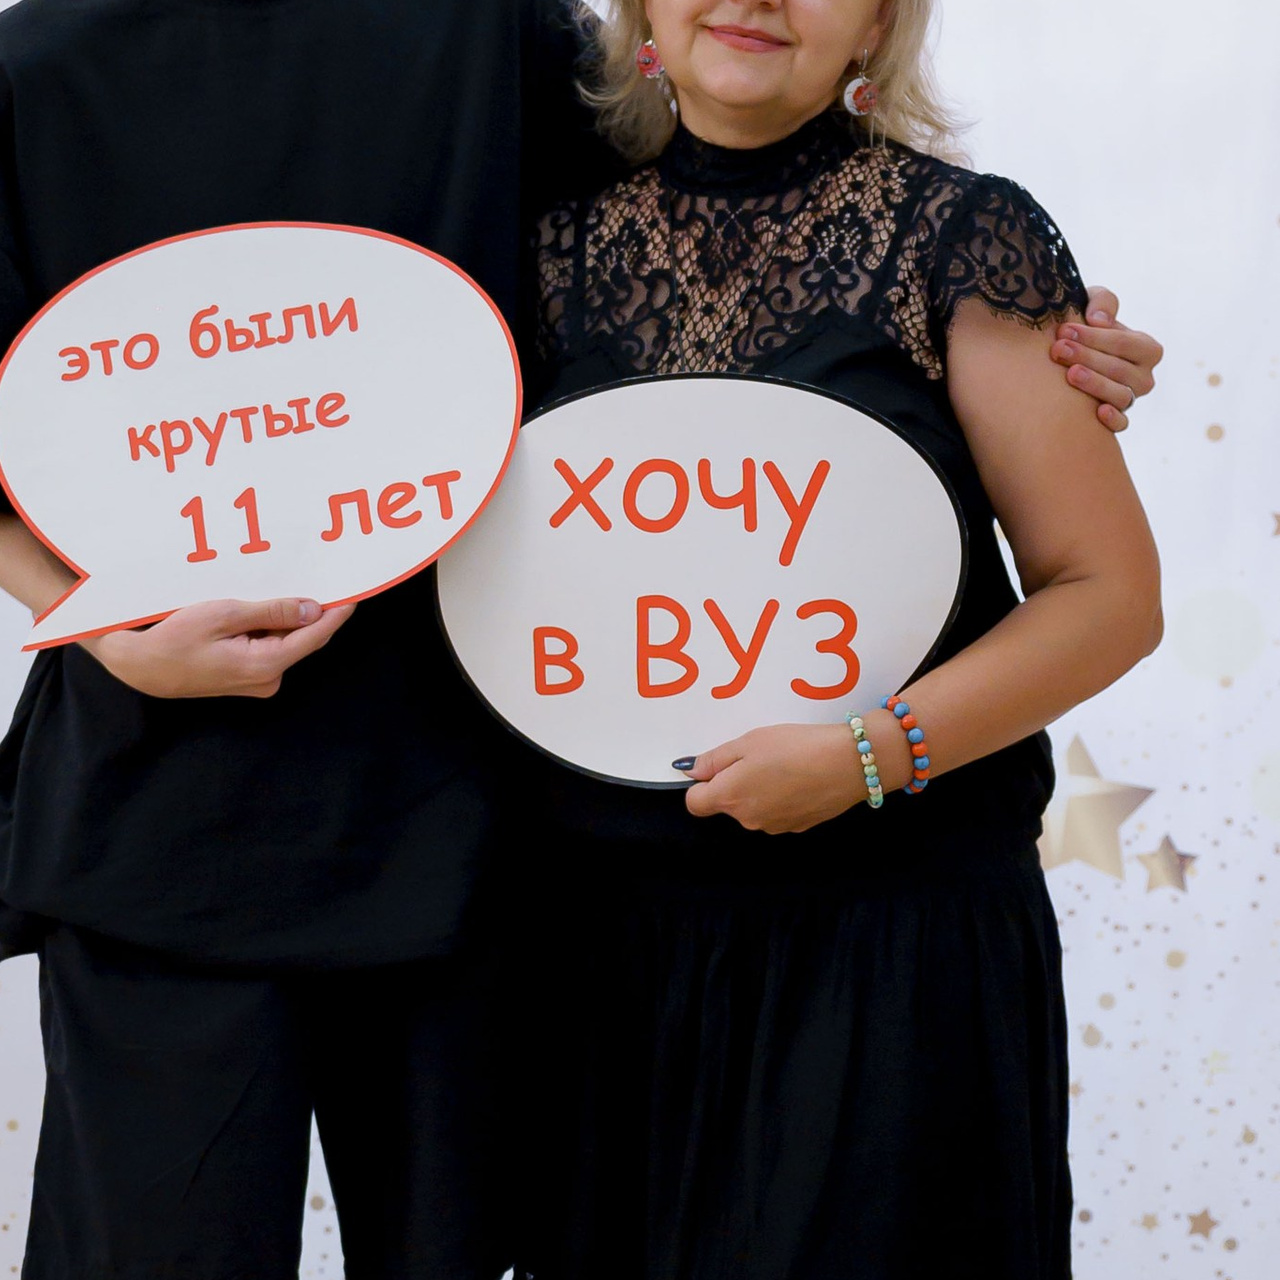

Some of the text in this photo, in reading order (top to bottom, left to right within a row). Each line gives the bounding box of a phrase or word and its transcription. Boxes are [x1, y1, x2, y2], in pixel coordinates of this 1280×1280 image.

[58, 297, 359, 382] это были
[127, 392, 350, 473] крутые
[180, 470, 462, 563] 11 лет
[549, 457, 831, 567] хочу
[635, 594, 862, 701] ВУЗ
